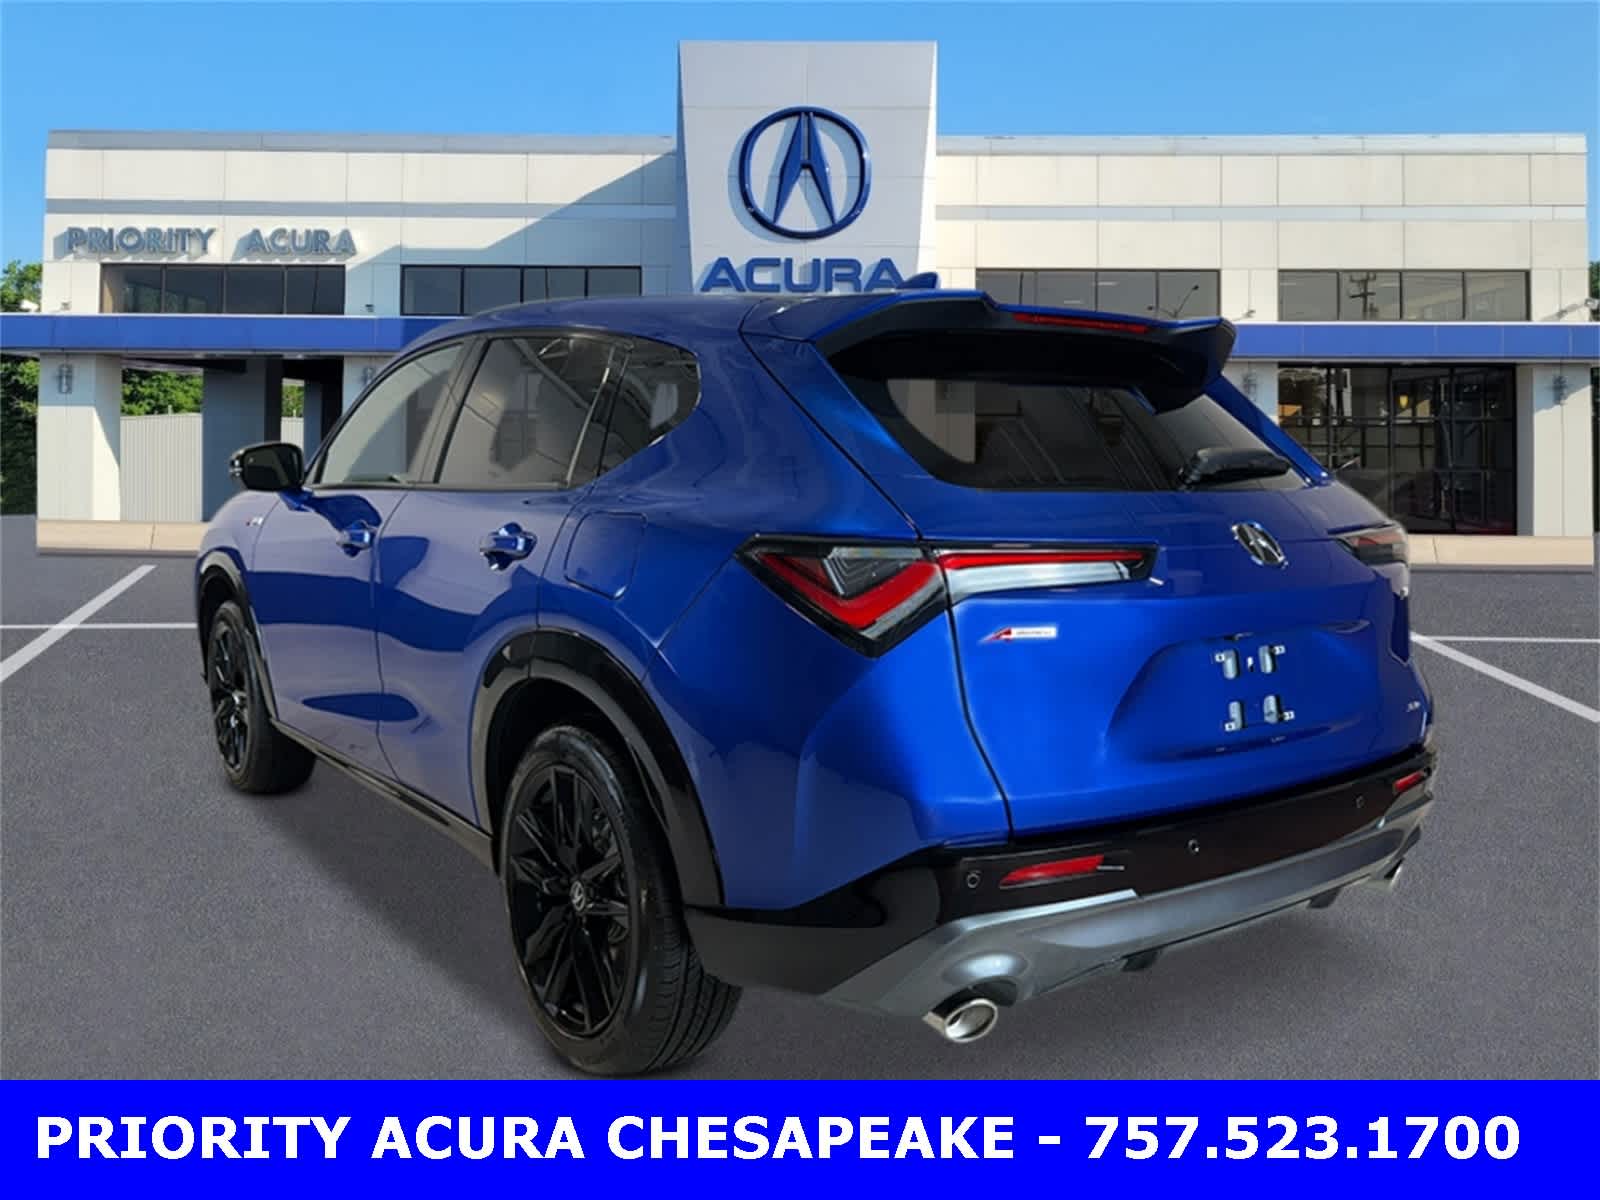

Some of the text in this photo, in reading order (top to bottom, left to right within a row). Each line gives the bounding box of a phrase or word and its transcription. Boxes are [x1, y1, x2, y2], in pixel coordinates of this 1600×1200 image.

[65, 226, 358, 256] PRIORITY ACURA
[700, 256, 905, 293] ACURA
